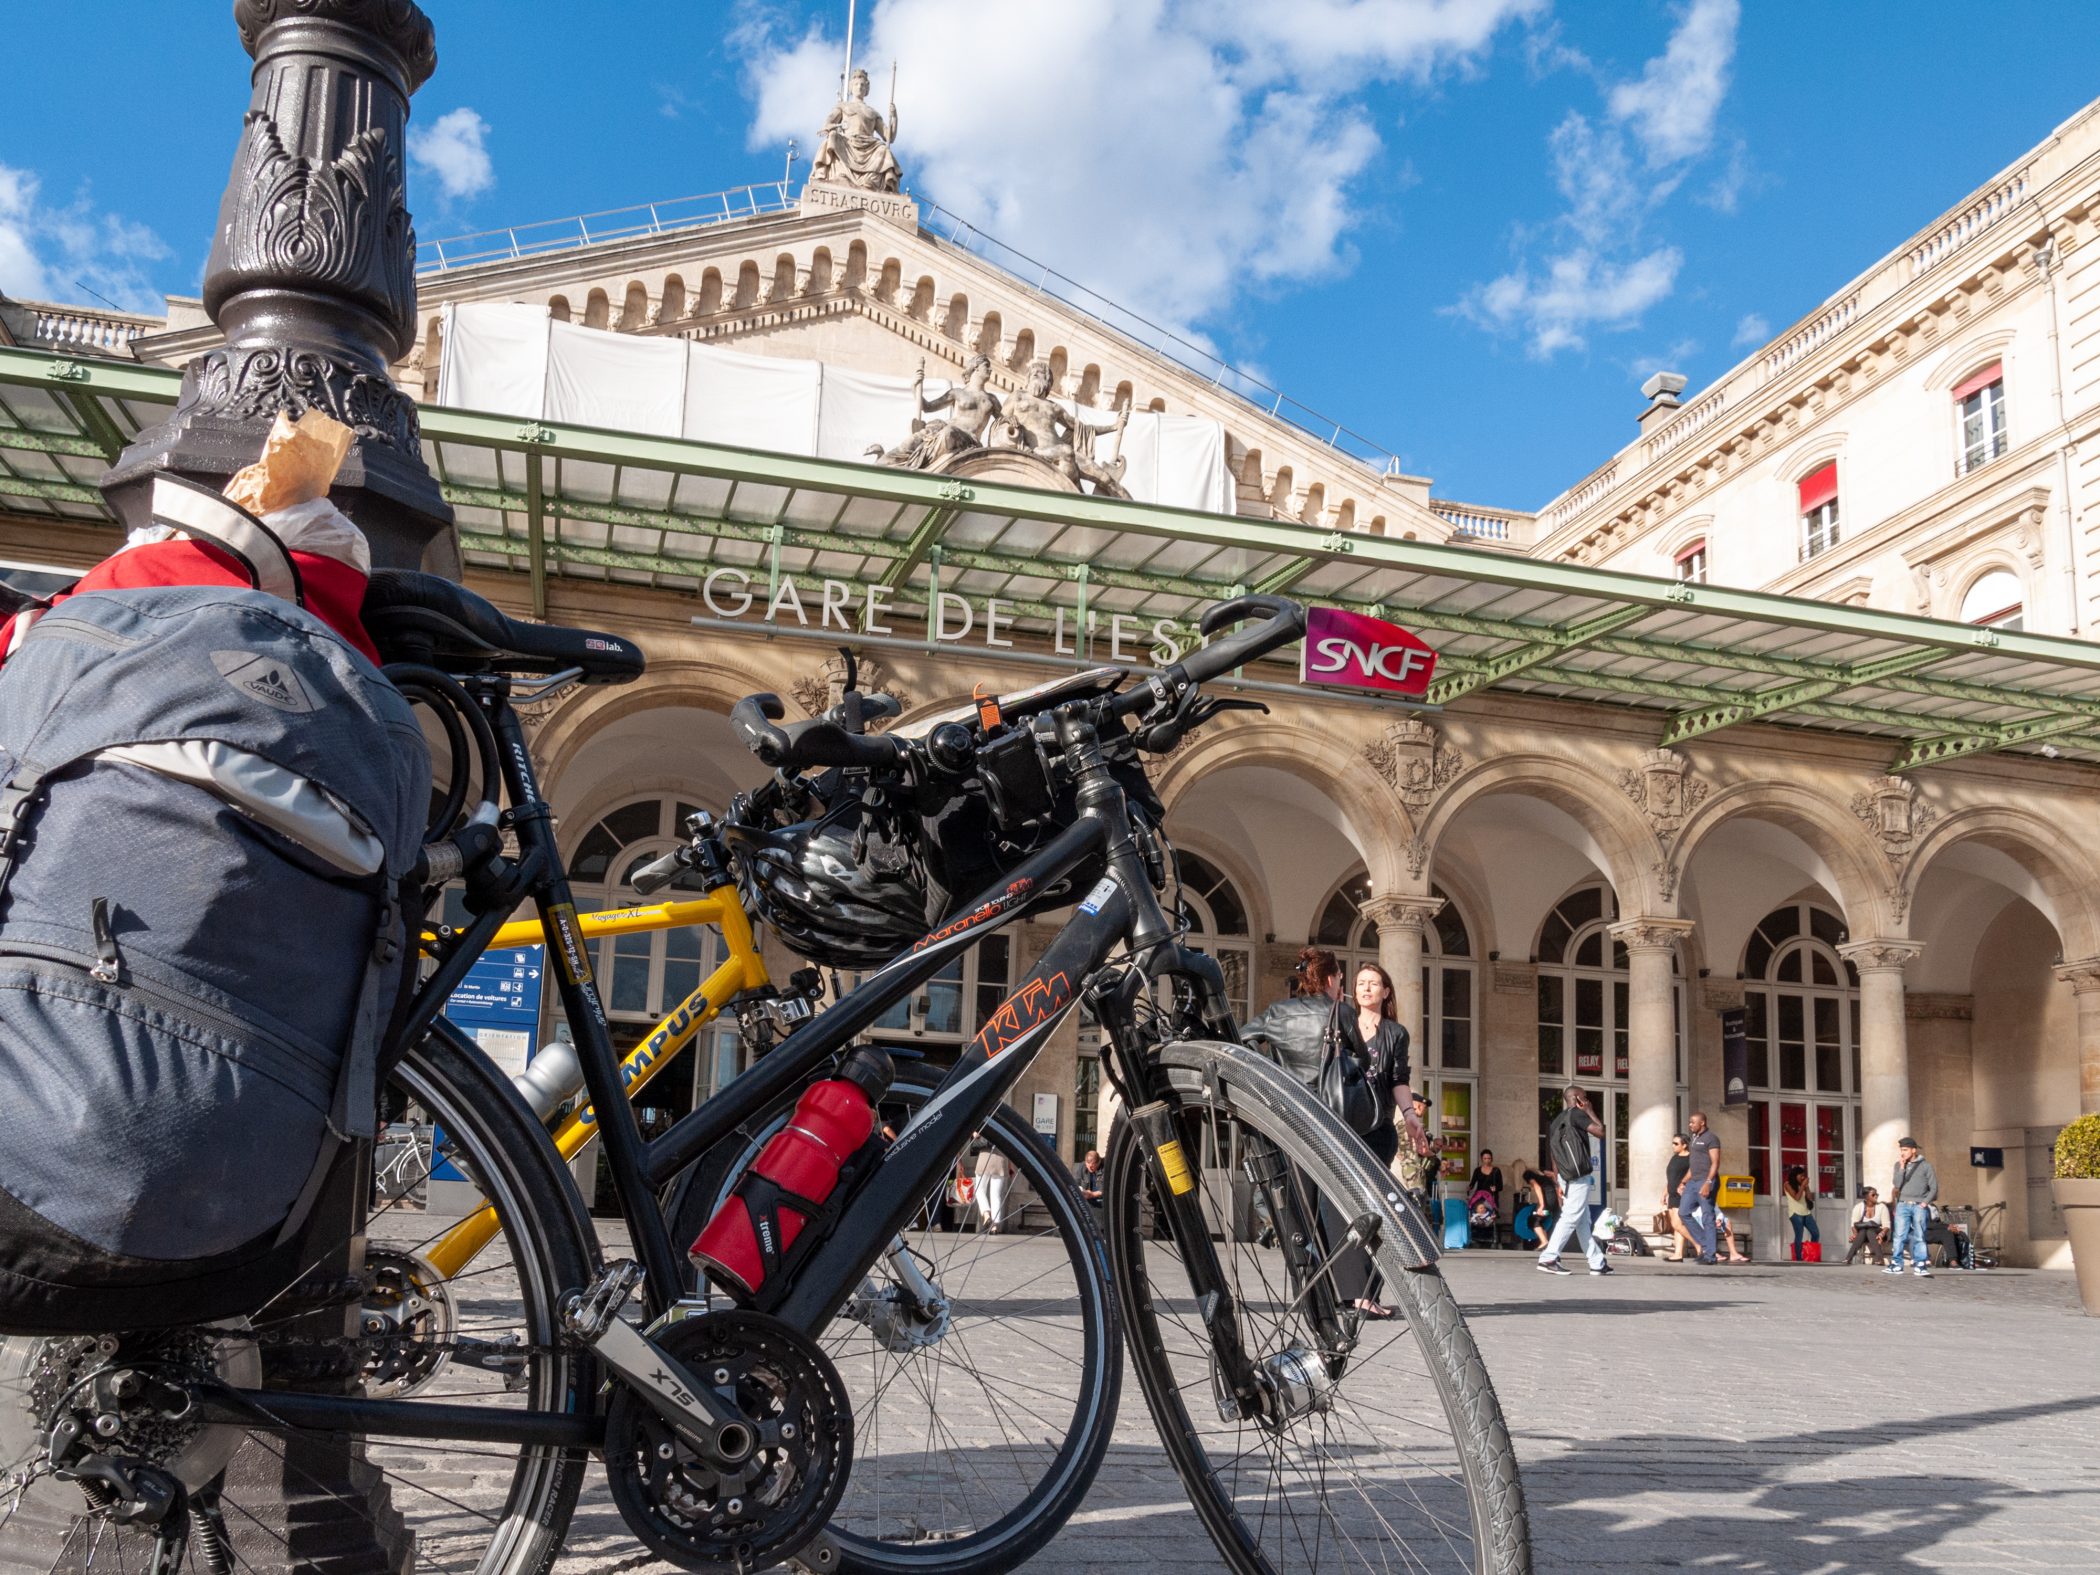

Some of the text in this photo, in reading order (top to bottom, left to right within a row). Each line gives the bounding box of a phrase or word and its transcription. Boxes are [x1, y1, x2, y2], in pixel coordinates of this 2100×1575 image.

[703, 567, 894, 634] GARE
[936, 591, 1015, 648] DE
[1310, 637, 1432, 681] SNCF
[512, 742, 536, 804] RITCHE
[913, 903, 1002, 952] Maranello
[476, 993, 484, 1001] de
[484, 994, 507, 1002] voitures
[972, 971, 1072, 1058] KTM
[1578, 1055, 1629, 1070] RELAY REL
[918, 1110, 943, 1135] model
[1035, 1117, 1055, 1125] GARE
[648, 1367, 695, 1407] SLX
[542, 1491, 559, 1526] RACER
